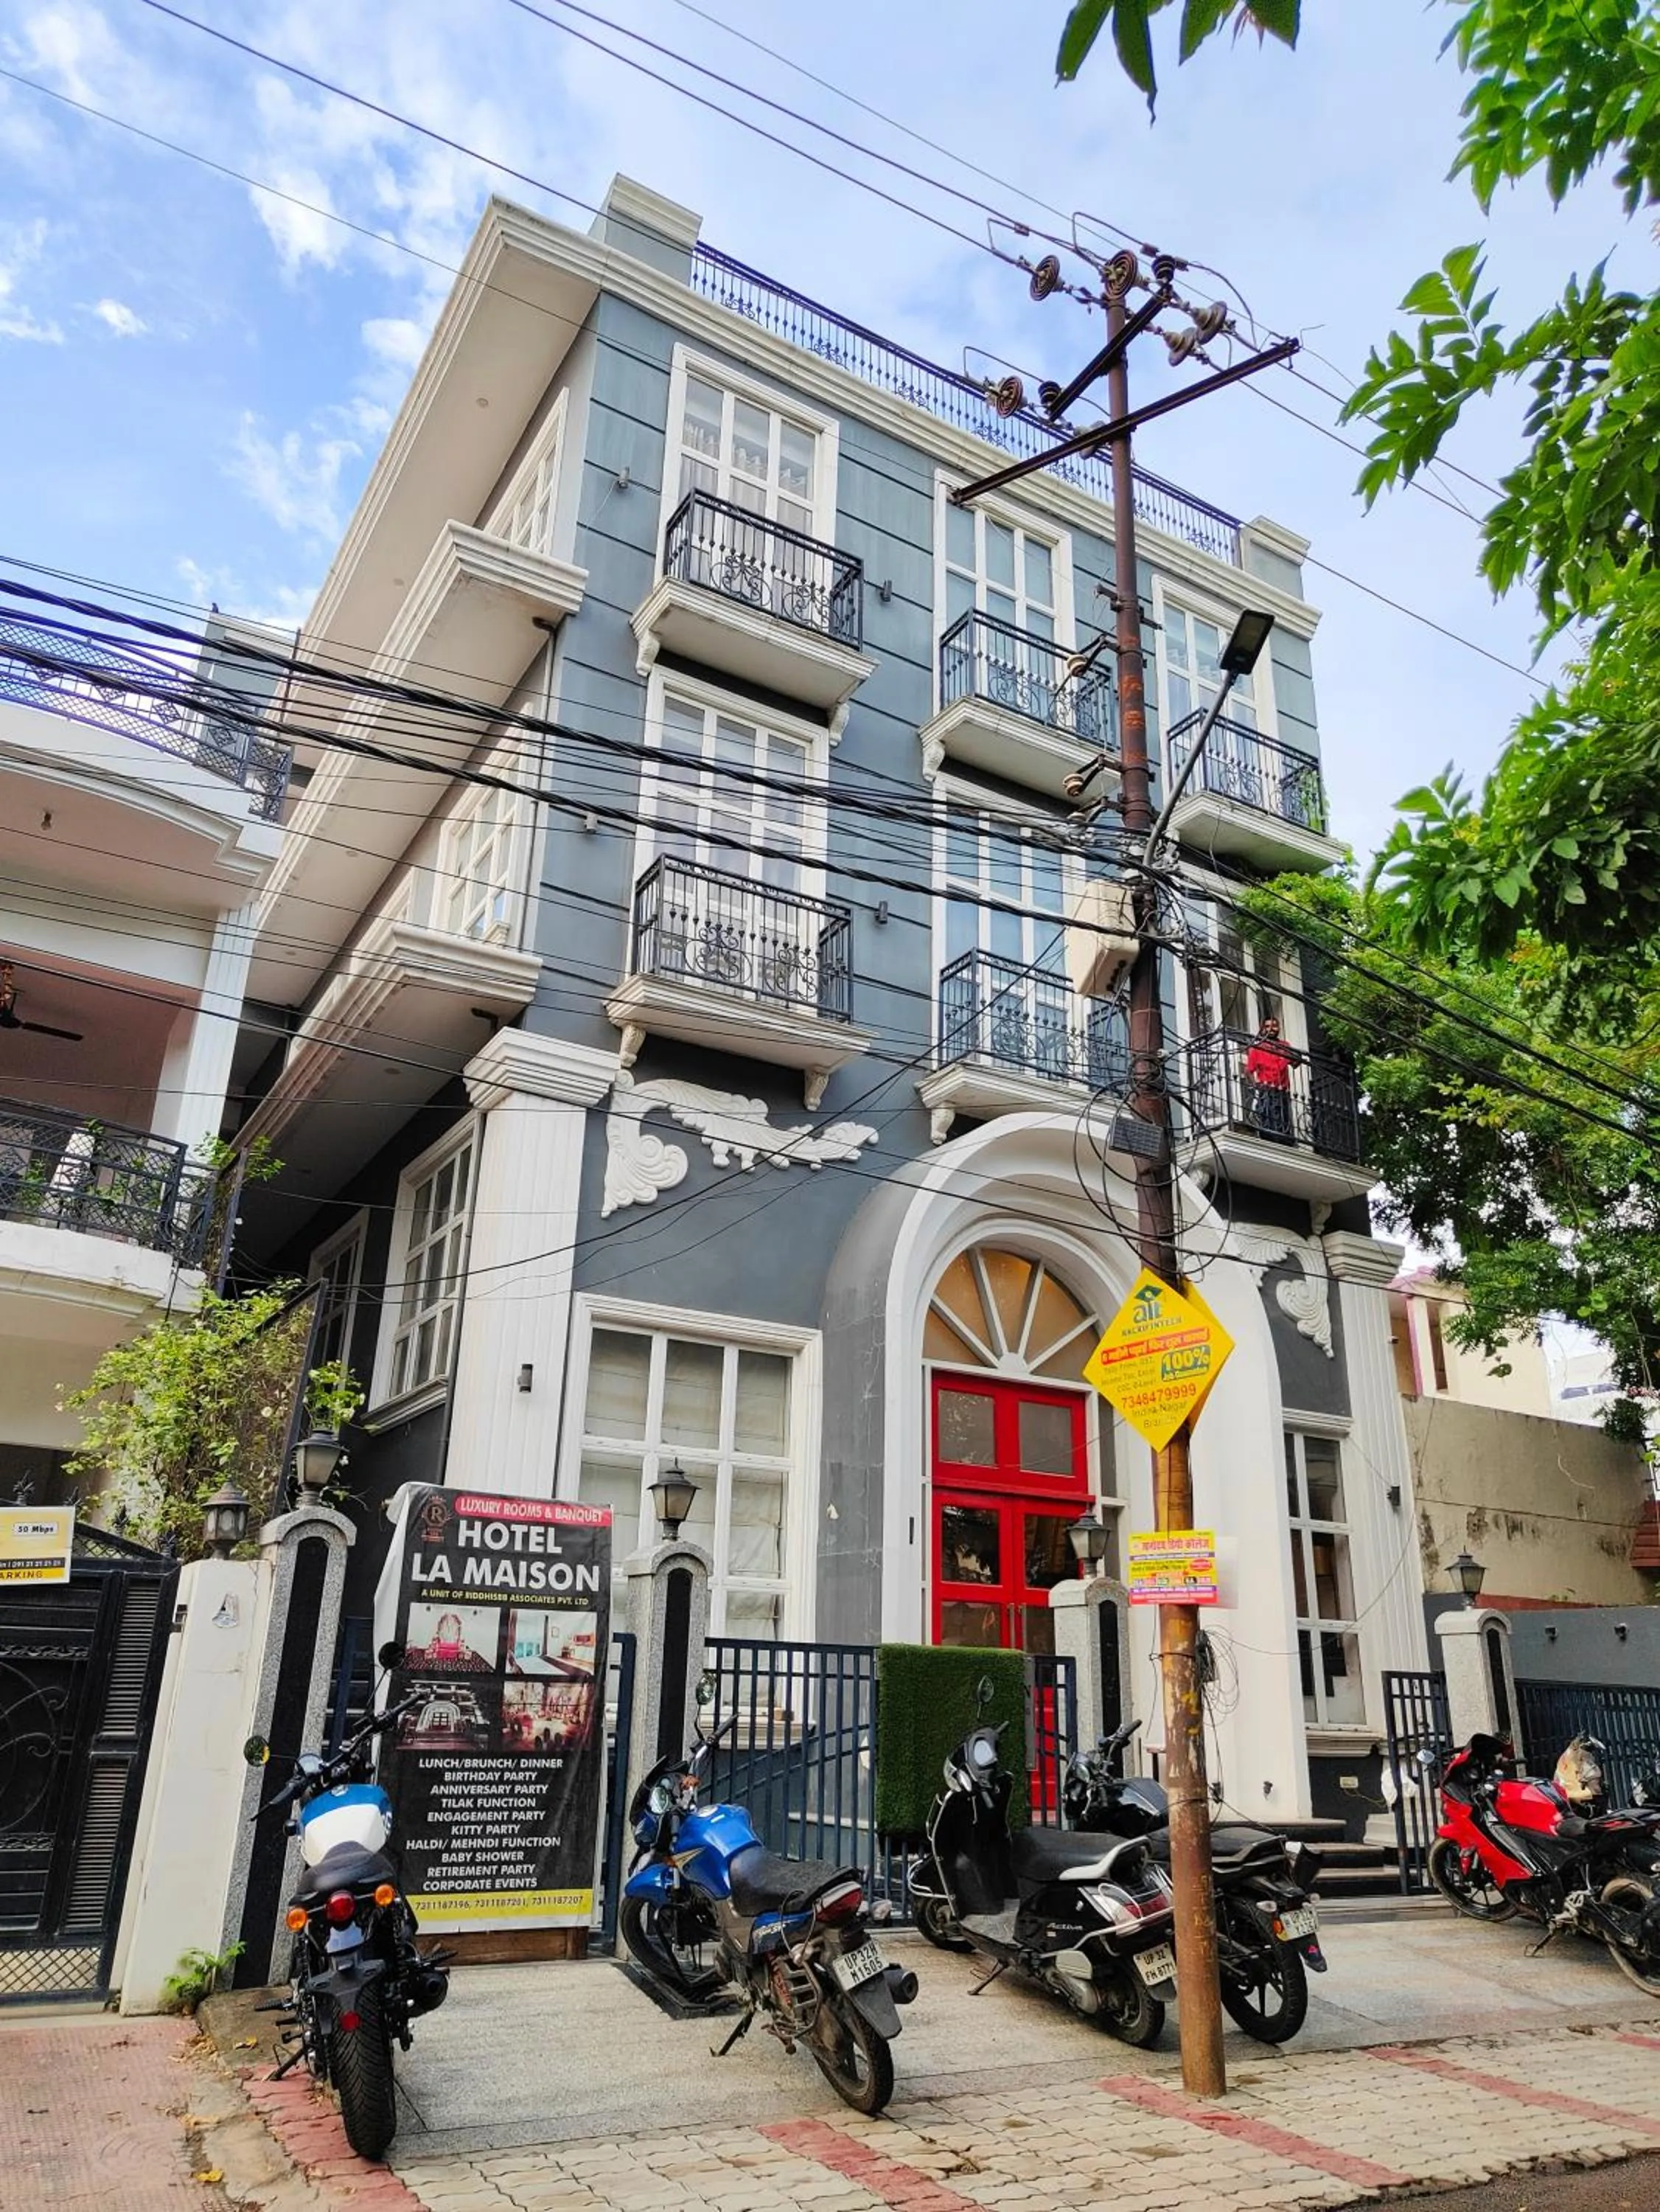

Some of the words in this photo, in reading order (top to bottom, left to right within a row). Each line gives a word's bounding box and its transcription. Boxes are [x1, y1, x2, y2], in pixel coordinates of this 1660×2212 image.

[1163, 1346, 1209, 1372] 100%
[1121, 1382, 1197, 1409] 7348479999
[461, 1498, 501, 1514] LUXURY
[503, 1502, 542, 1517] ROOMS
[544, 1506, 553, 1518] &
[555, 1509, 603, 1523] BANQUET
[31, 1525, 54, 1534] Mbps
[458, 1520, 562, 1554] HOTEL
[411, 1553, 453, 1583] LA
[463, 1557, 600, 1592] MAISON
[430, 1590, 449, 1598] UNIT
[452, 1590, 463, 1599] OF
[509, 1593, 555, 1604] ASSOCIATES
[574, 1597, 589, 1606] LTD
[520, 1758, 563, 1768] DINNER
[444, 1772, 501, 1781] BIRTHDAY
[503, 1771, 537, 1781] PARTY
[430, 1784, 512, 1795] ANNIVERSARY
[514, 1784, 548, 1795] PARTY
[442, 1798, 474, 1808] TILAK
[477, 1798, 536, 1808] FUNCTION
[427, 1812, 509, 1822] ENGAGEMENT
[512, 1811, 545, 1821] PARTY
[451, 1825, 484, 1835] KITTY
[486, 1824, 520, 1834] PARTY
[406, 1839, 448, 1851] HALDI/
[450, 1838, 499, 1849] MEHNDI
[502, 1837, 561, 1848] FUNCTION
[442, 1852, 472, 1863] BABY
[475, 1851, 524, 1862] SHOWER
[427, 1866, 498, 1877] RETIREMENT
[501, 1865, 535, 1876] PARTY
[423, 1879, 492, 1891] CORPORATE
[495, 1878, 537, 1889] EVENTS
